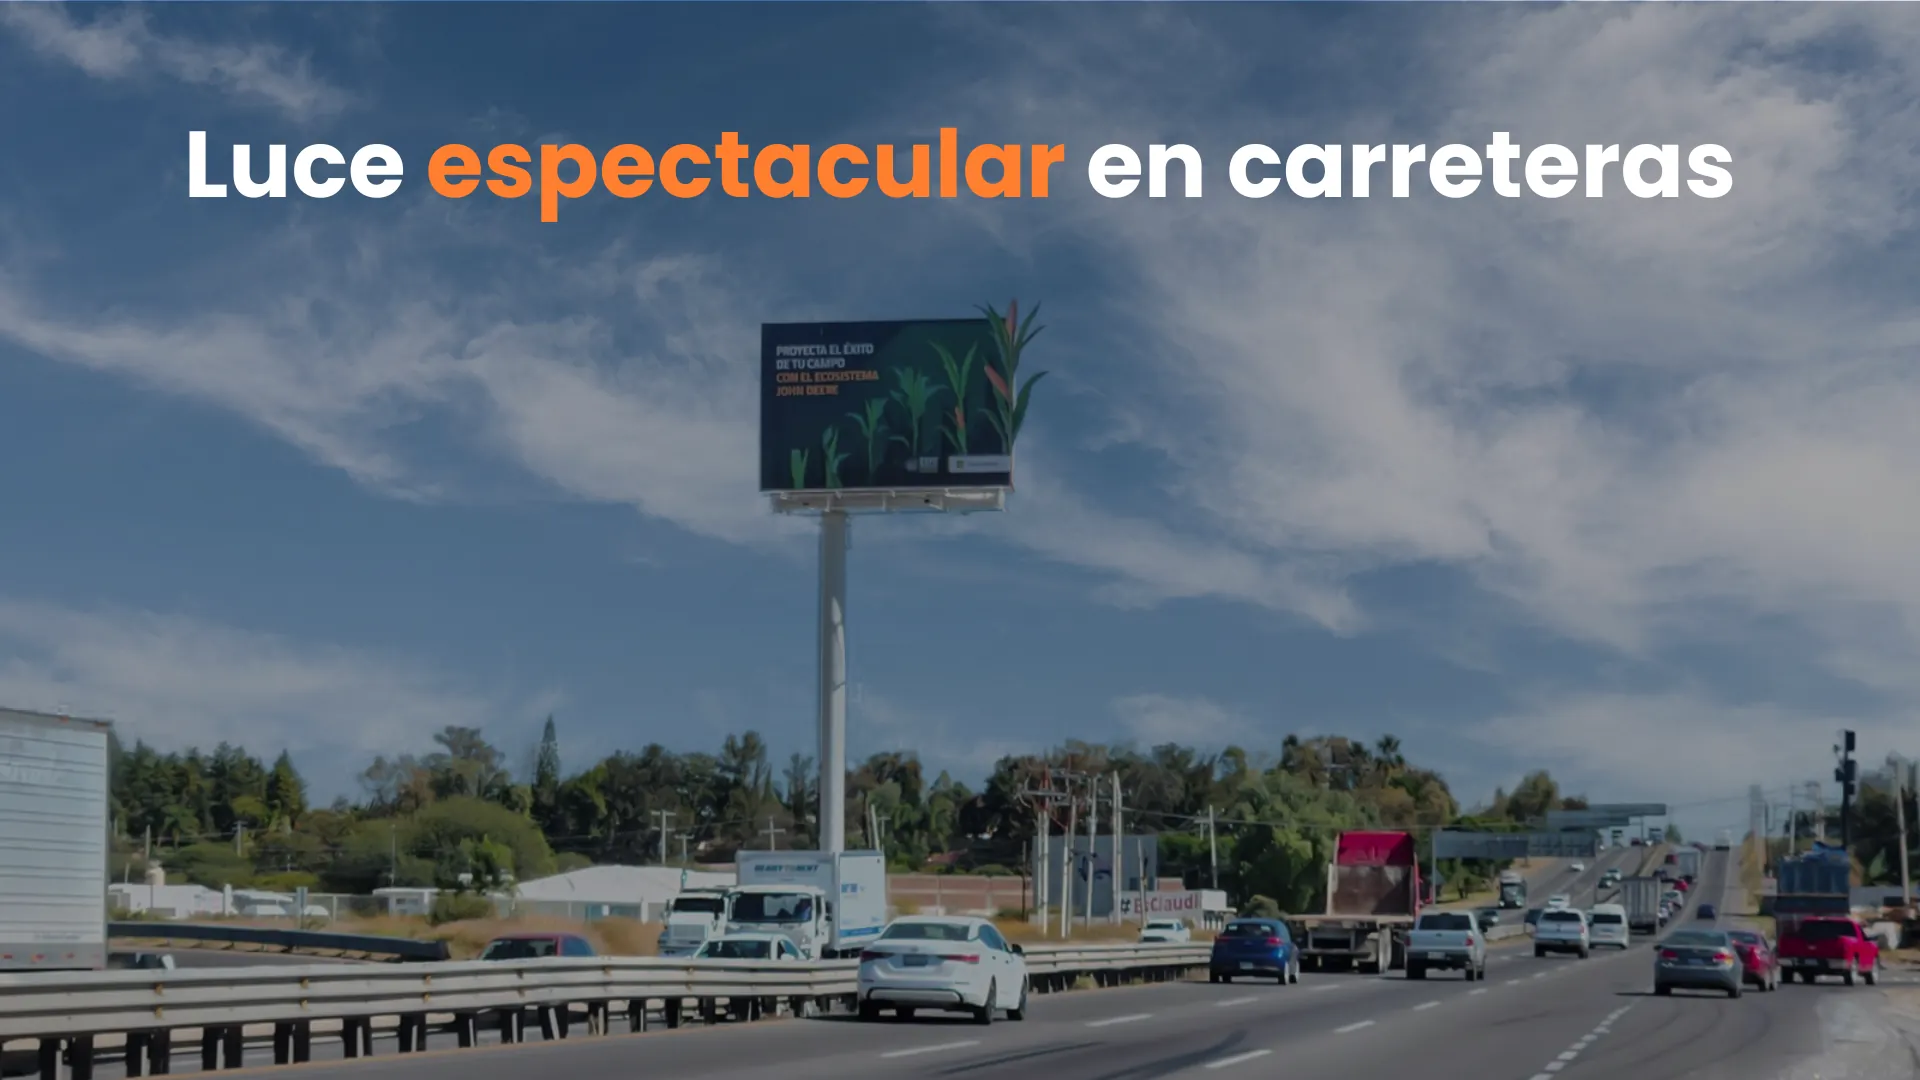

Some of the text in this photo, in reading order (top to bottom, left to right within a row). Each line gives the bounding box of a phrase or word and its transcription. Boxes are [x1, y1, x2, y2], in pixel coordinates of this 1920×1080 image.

[776, 342, 874, 356] PROYECTA EL ÉXITO
[776, 357, 846, 370] DE TU CAMPO
[776, 370, 879, 383] CON EL ECOSISTEMA
[776, 385, 804, 396] JOHN
